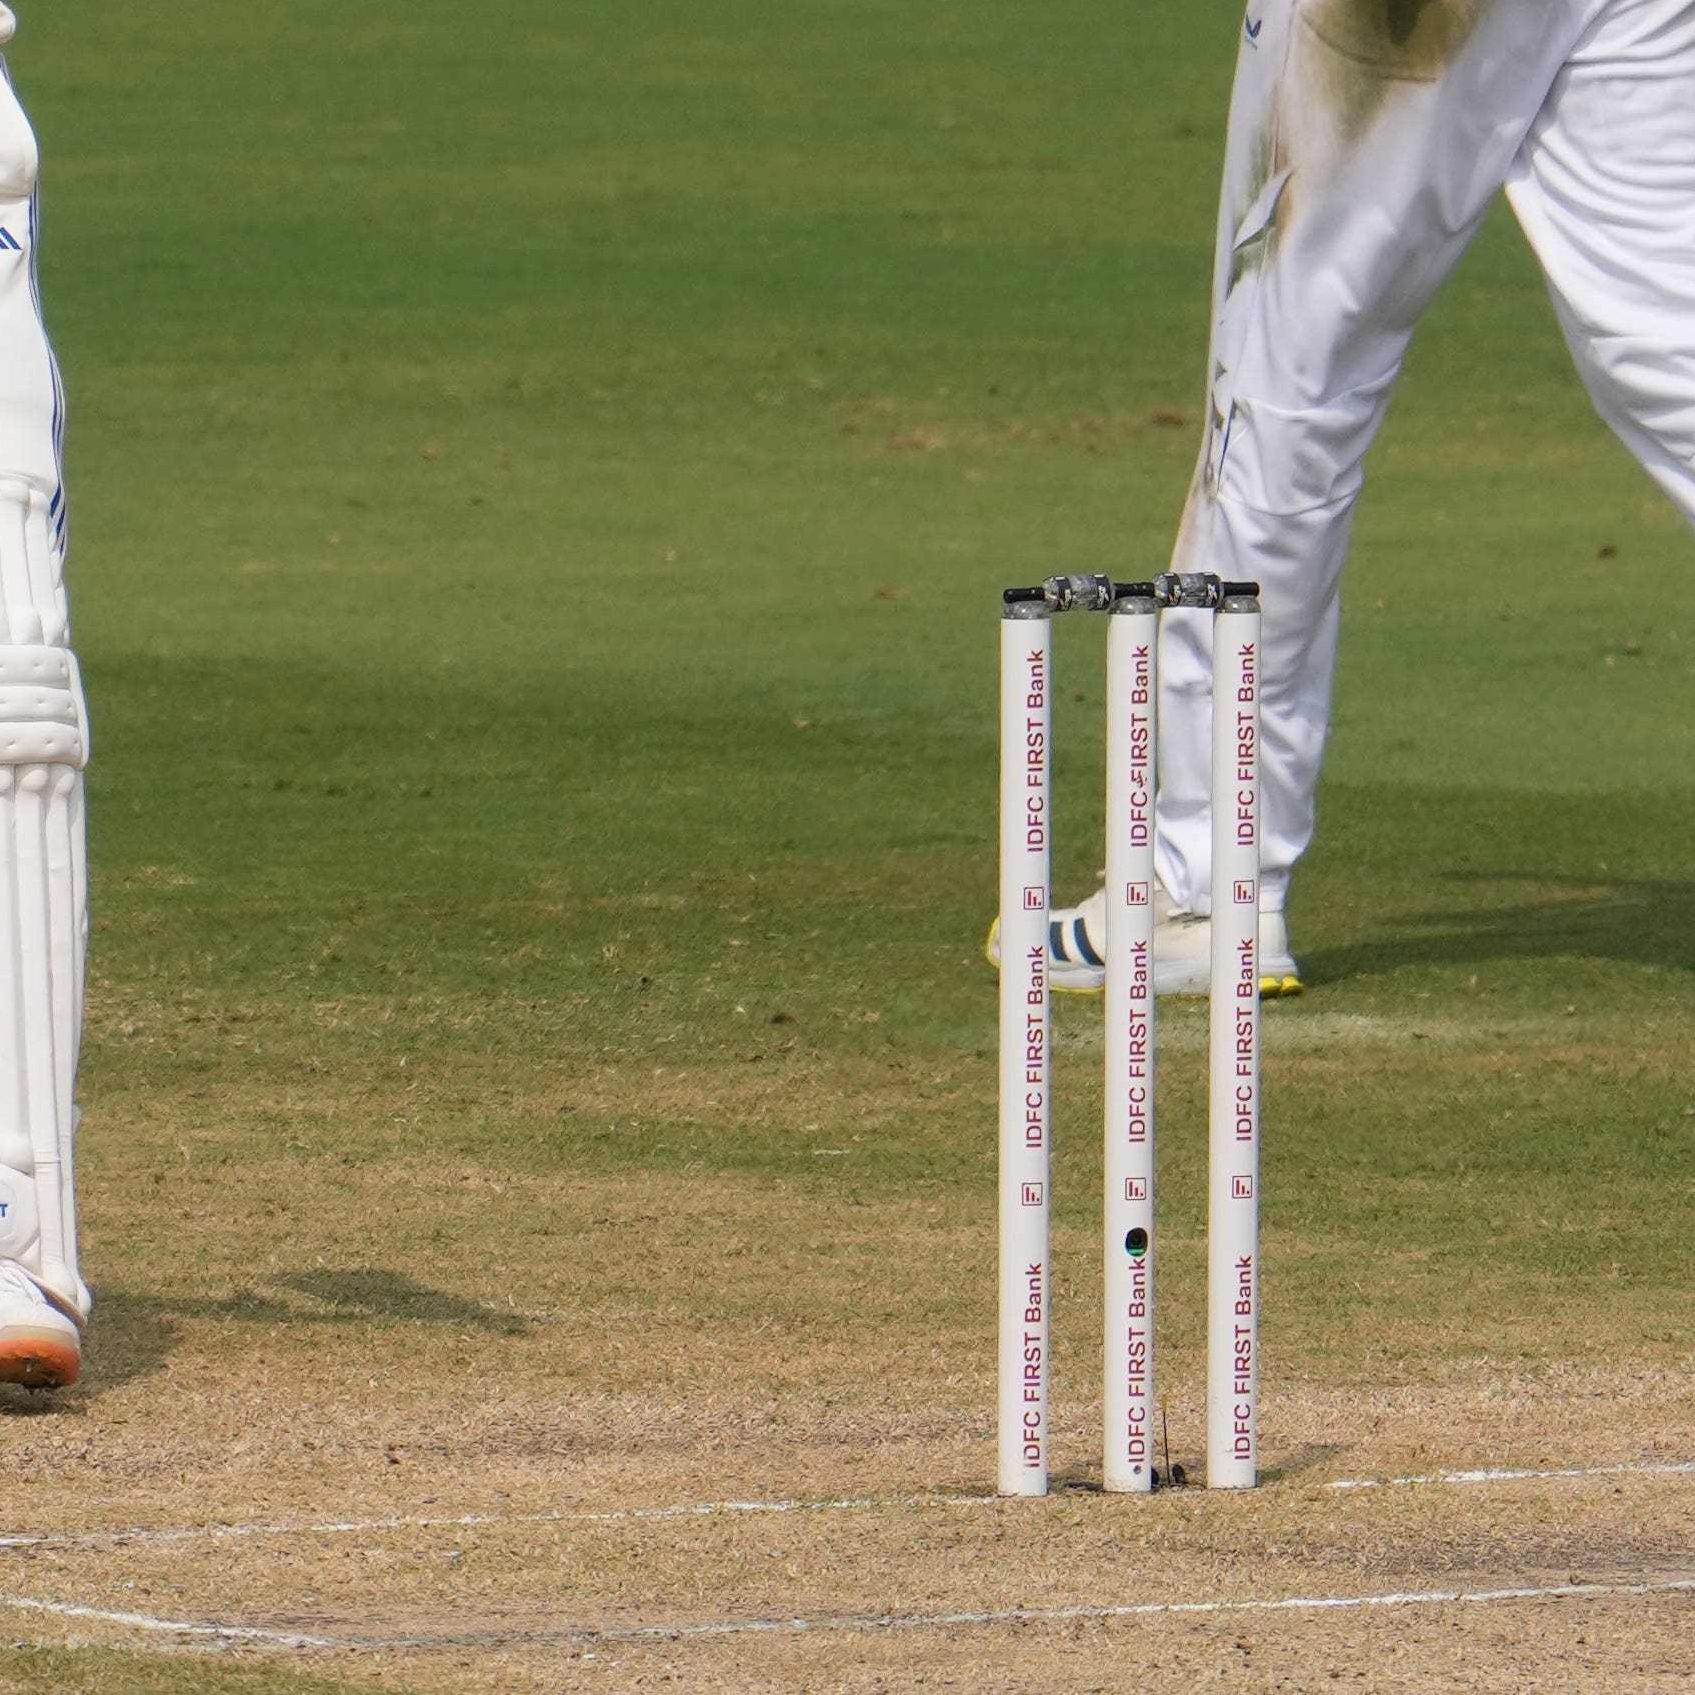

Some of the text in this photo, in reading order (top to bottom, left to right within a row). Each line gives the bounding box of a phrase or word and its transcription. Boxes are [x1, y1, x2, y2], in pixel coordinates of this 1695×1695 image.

[1026, 649, 1044, 852] IDFC FIRST Bank
[1131, 644, 1149, 705] Bank
[1237, 641, 1255, 846] IDFC FIRST Bank
[1130, 791, 1148, 847] IDFC
[1025, 946, 1044, 1148] IDFC FIRST Bank
[1128, 940, 1147, 1143] IDFC FIRST Bank
[1235, 939, 1254, 1141] IDFC FIRST Bank
[1023, 1262, 1042, 1468] IDFC FIRST Bank
[1128, 1257, 1146, 1463] IDFC FIRST Bank
[1233, 1253, 1252, 1460] IDFC FIRST Bank
